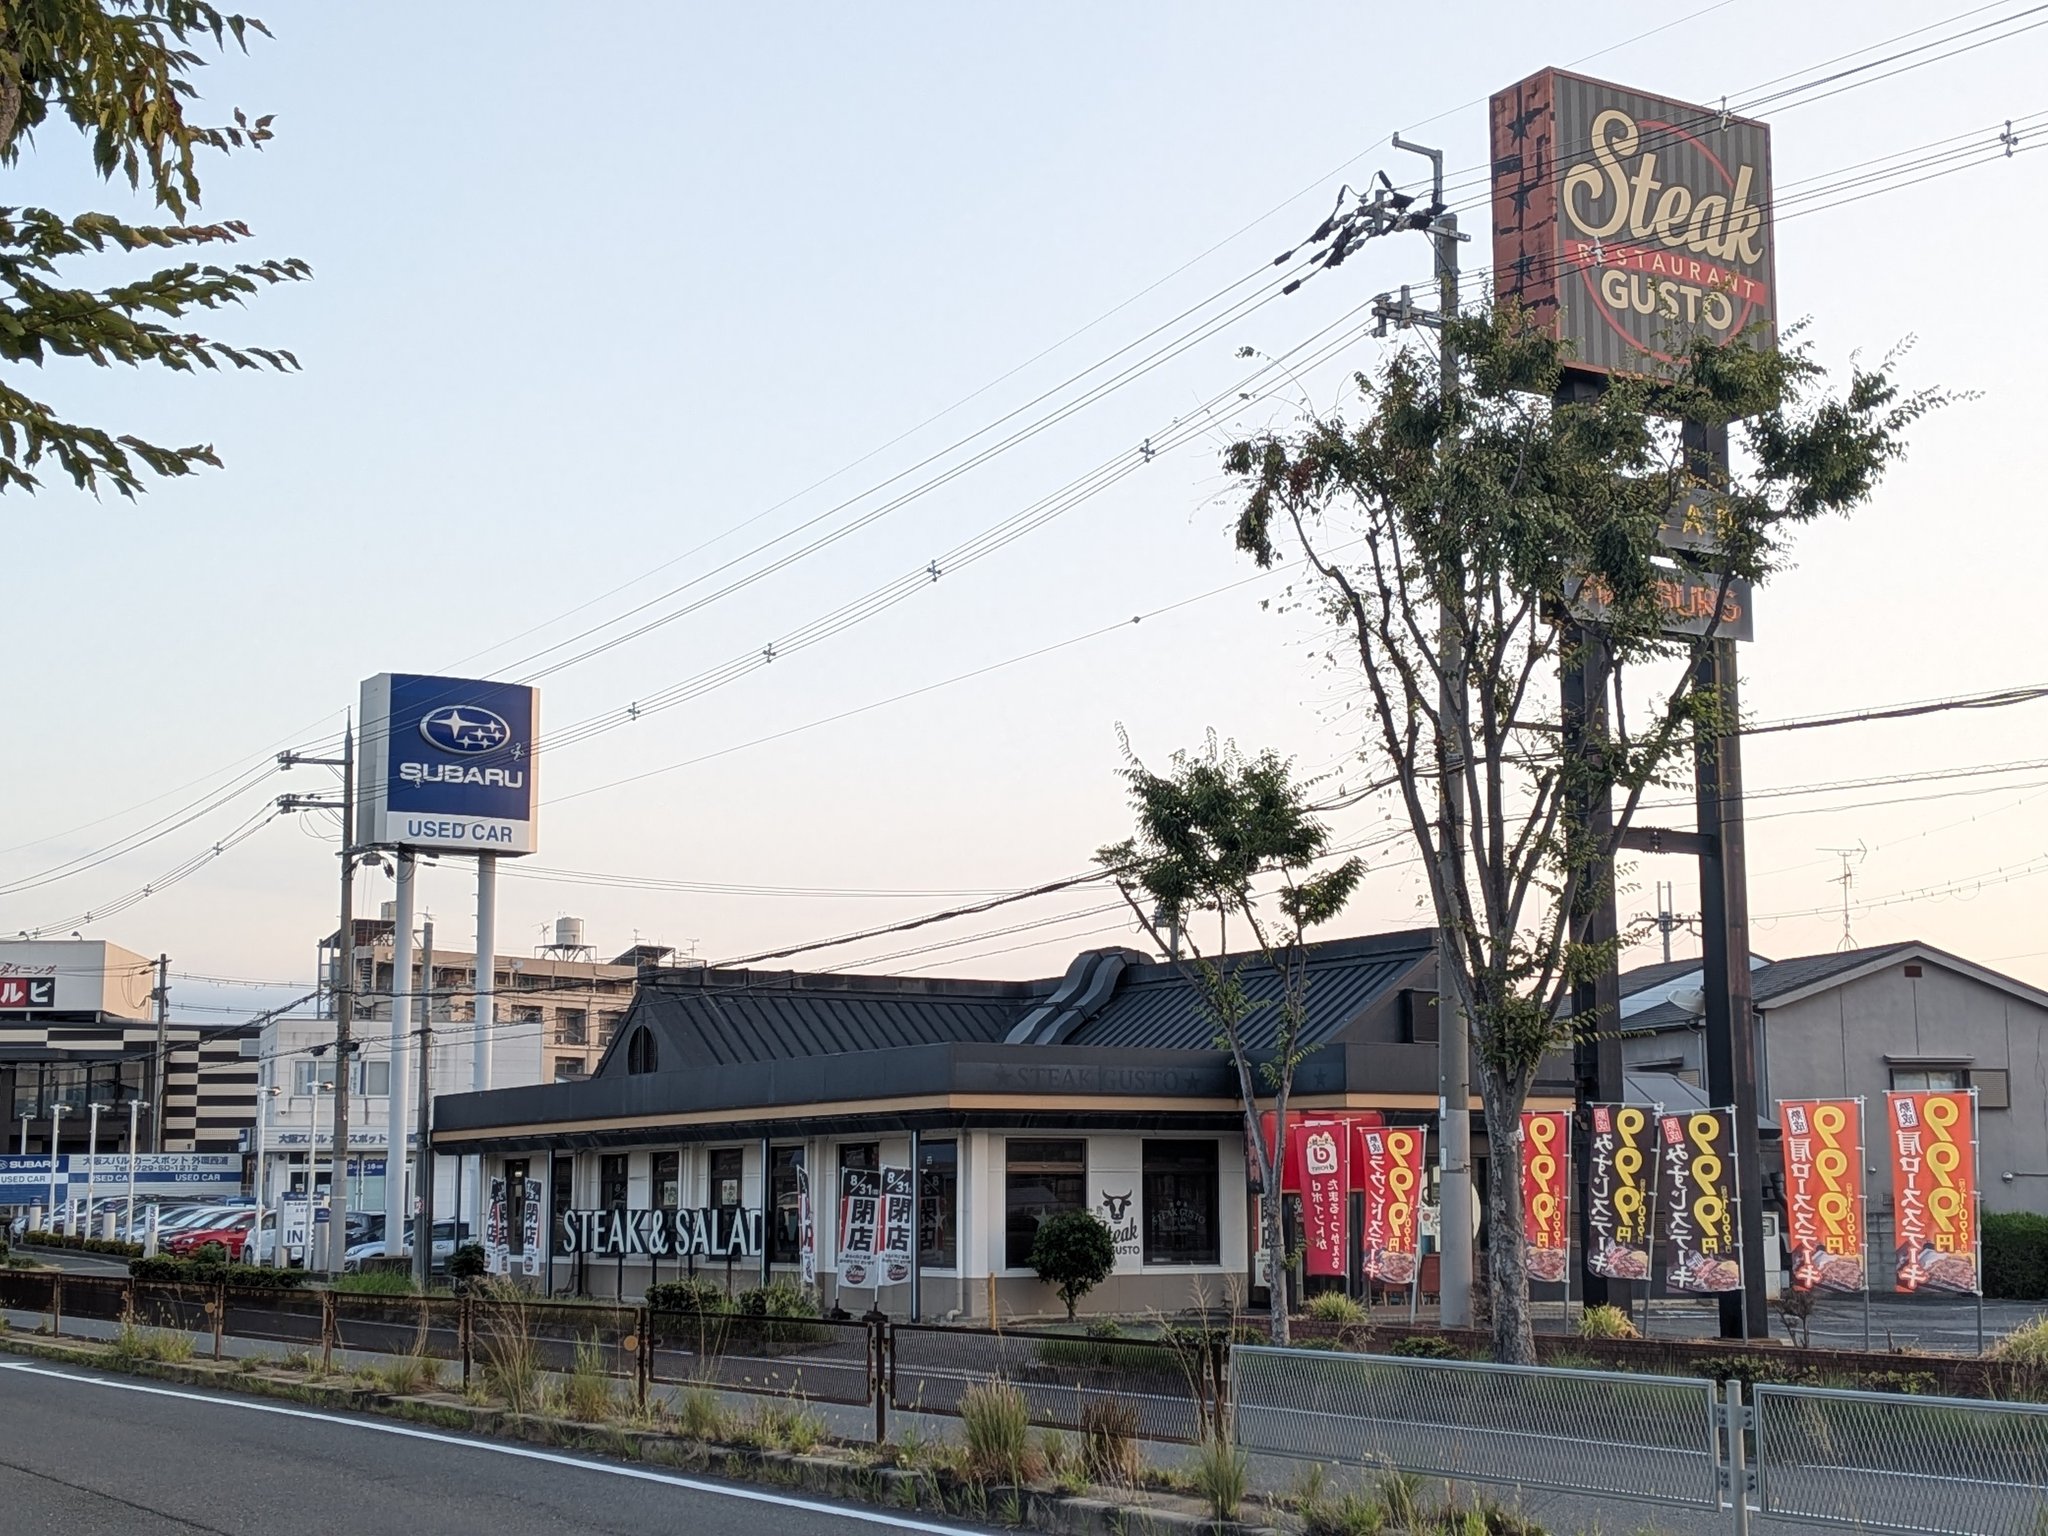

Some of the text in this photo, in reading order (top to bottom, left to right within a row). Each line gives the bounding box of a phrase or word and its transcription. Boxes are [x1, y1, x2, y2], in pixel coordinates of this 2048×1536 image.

[1563, 109, 1764, 265] Steak
[1601, 270, 1733, 330] GUSTO
[399, 762, 523, 789] SUBARU
[408, 820, 512, 843] USED CAR
[1017, 1067, 1179, 1093] STEAK GUSTO
[1, 1175, 25, 1183] USED
[175, 1173, 221, 1181] USED CAR
[287, 1230, 303, 1243] IN
[563, 1209, 644, 1253] STEAK
[649, 1210, 669, 1255] &
[847, 1199, 876, 1252] 閉店
[886, 1196, 911, 1252] 閉店
